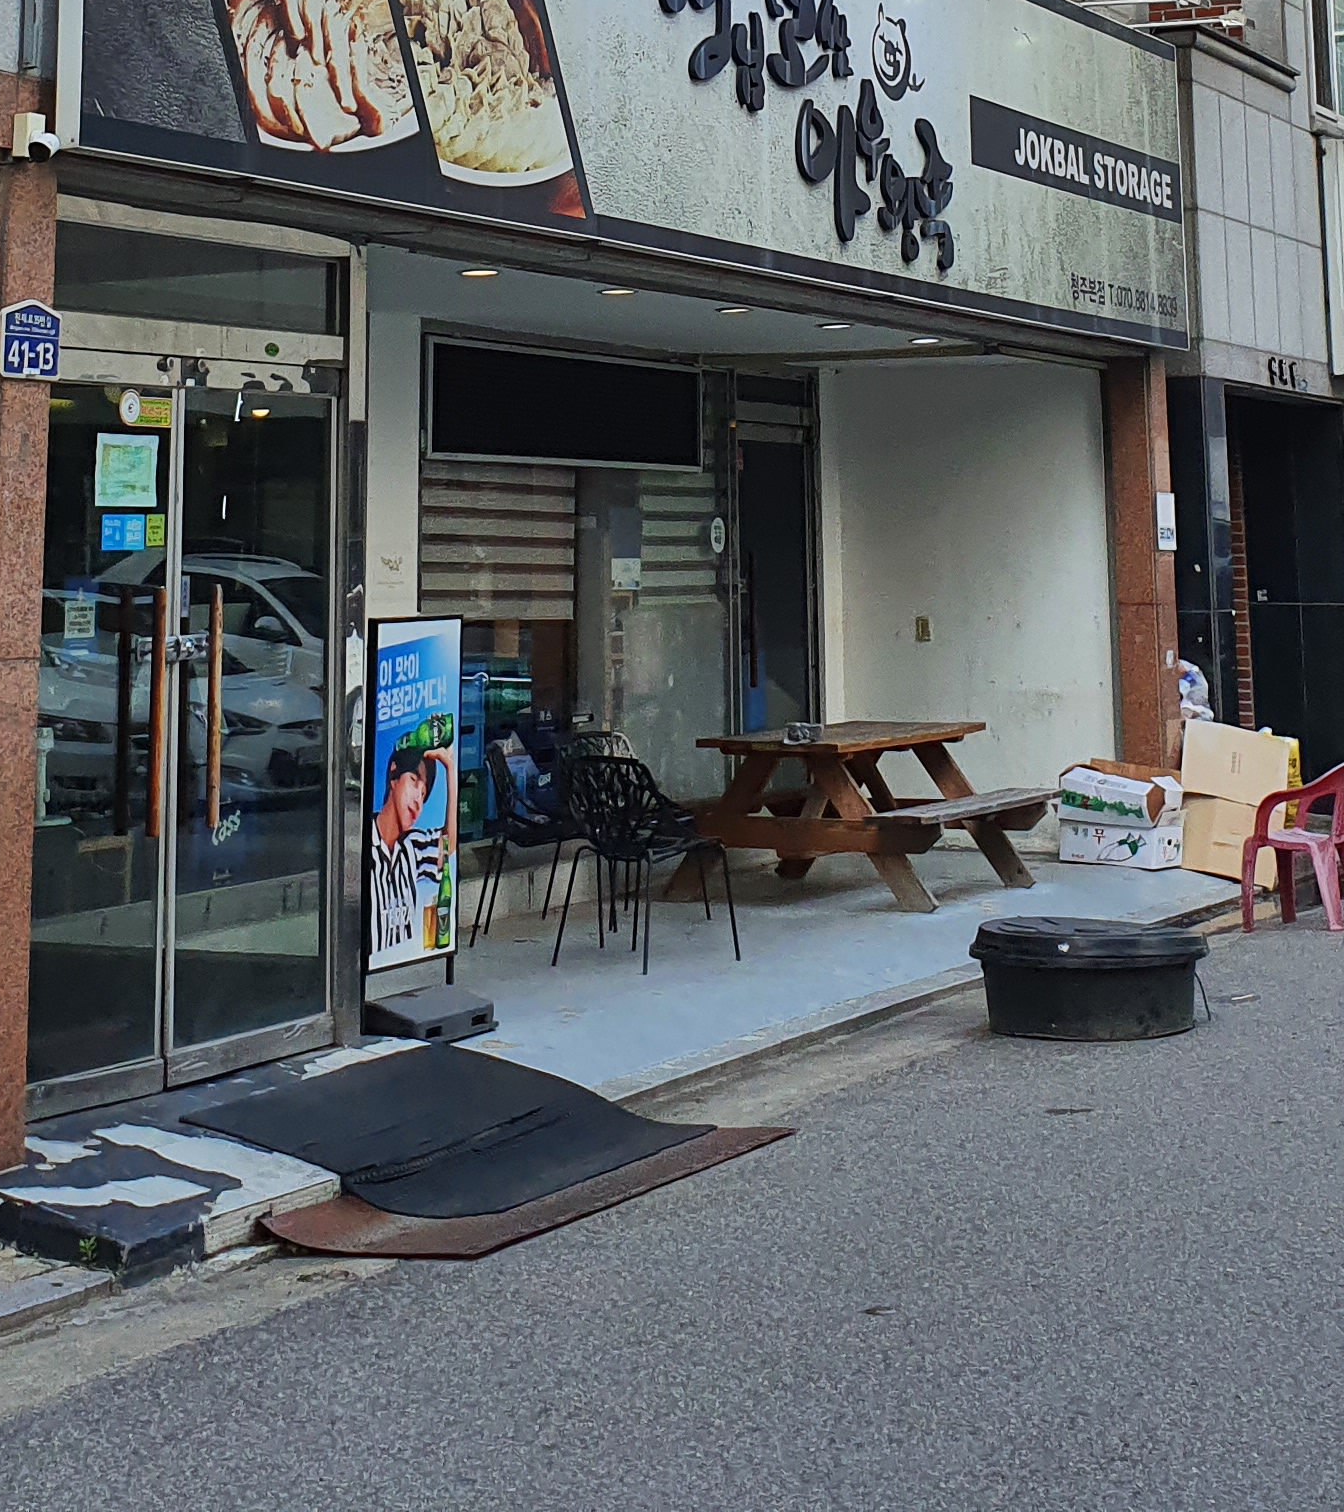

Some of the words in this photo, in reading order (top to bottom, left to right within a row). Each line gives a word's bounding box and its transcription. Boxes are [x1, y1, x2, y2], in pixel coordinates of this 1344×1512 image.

[1013, 126, 1090, 186] JOKBAL
[1093, 152, 1175, 211] STORAGE
[1070, 271, 1106, 306] 청주본점
[7, 339, 55, 371] 41-13
[379, 658, 392, 687] 이
[395, 651, 420, 684] 맛이
